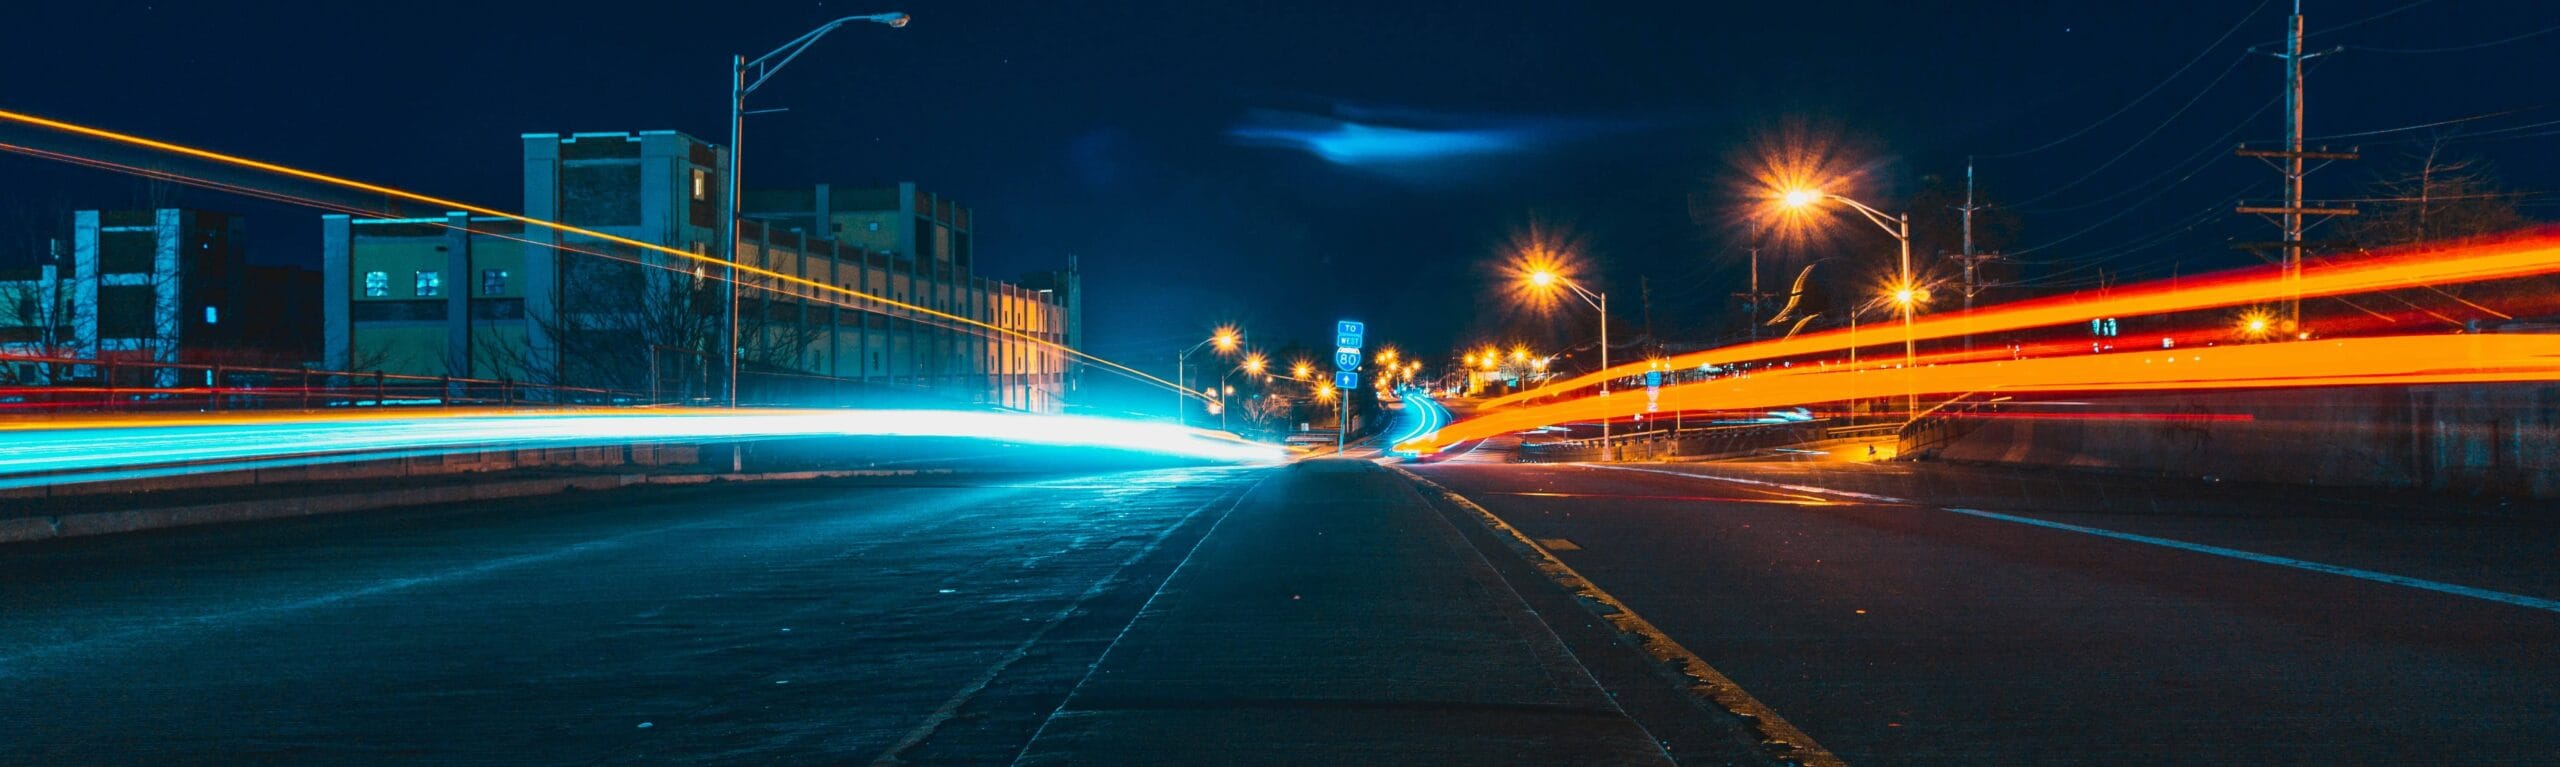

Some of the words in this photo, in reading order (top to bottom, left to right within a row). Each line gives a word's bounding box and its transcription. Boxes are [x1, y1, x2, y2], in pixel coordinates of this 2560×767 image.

[1345, 324, 1356, 332] TO
[1341, 337, 1359, 345] WEST
[1340, 354, 1356, 365] 80
